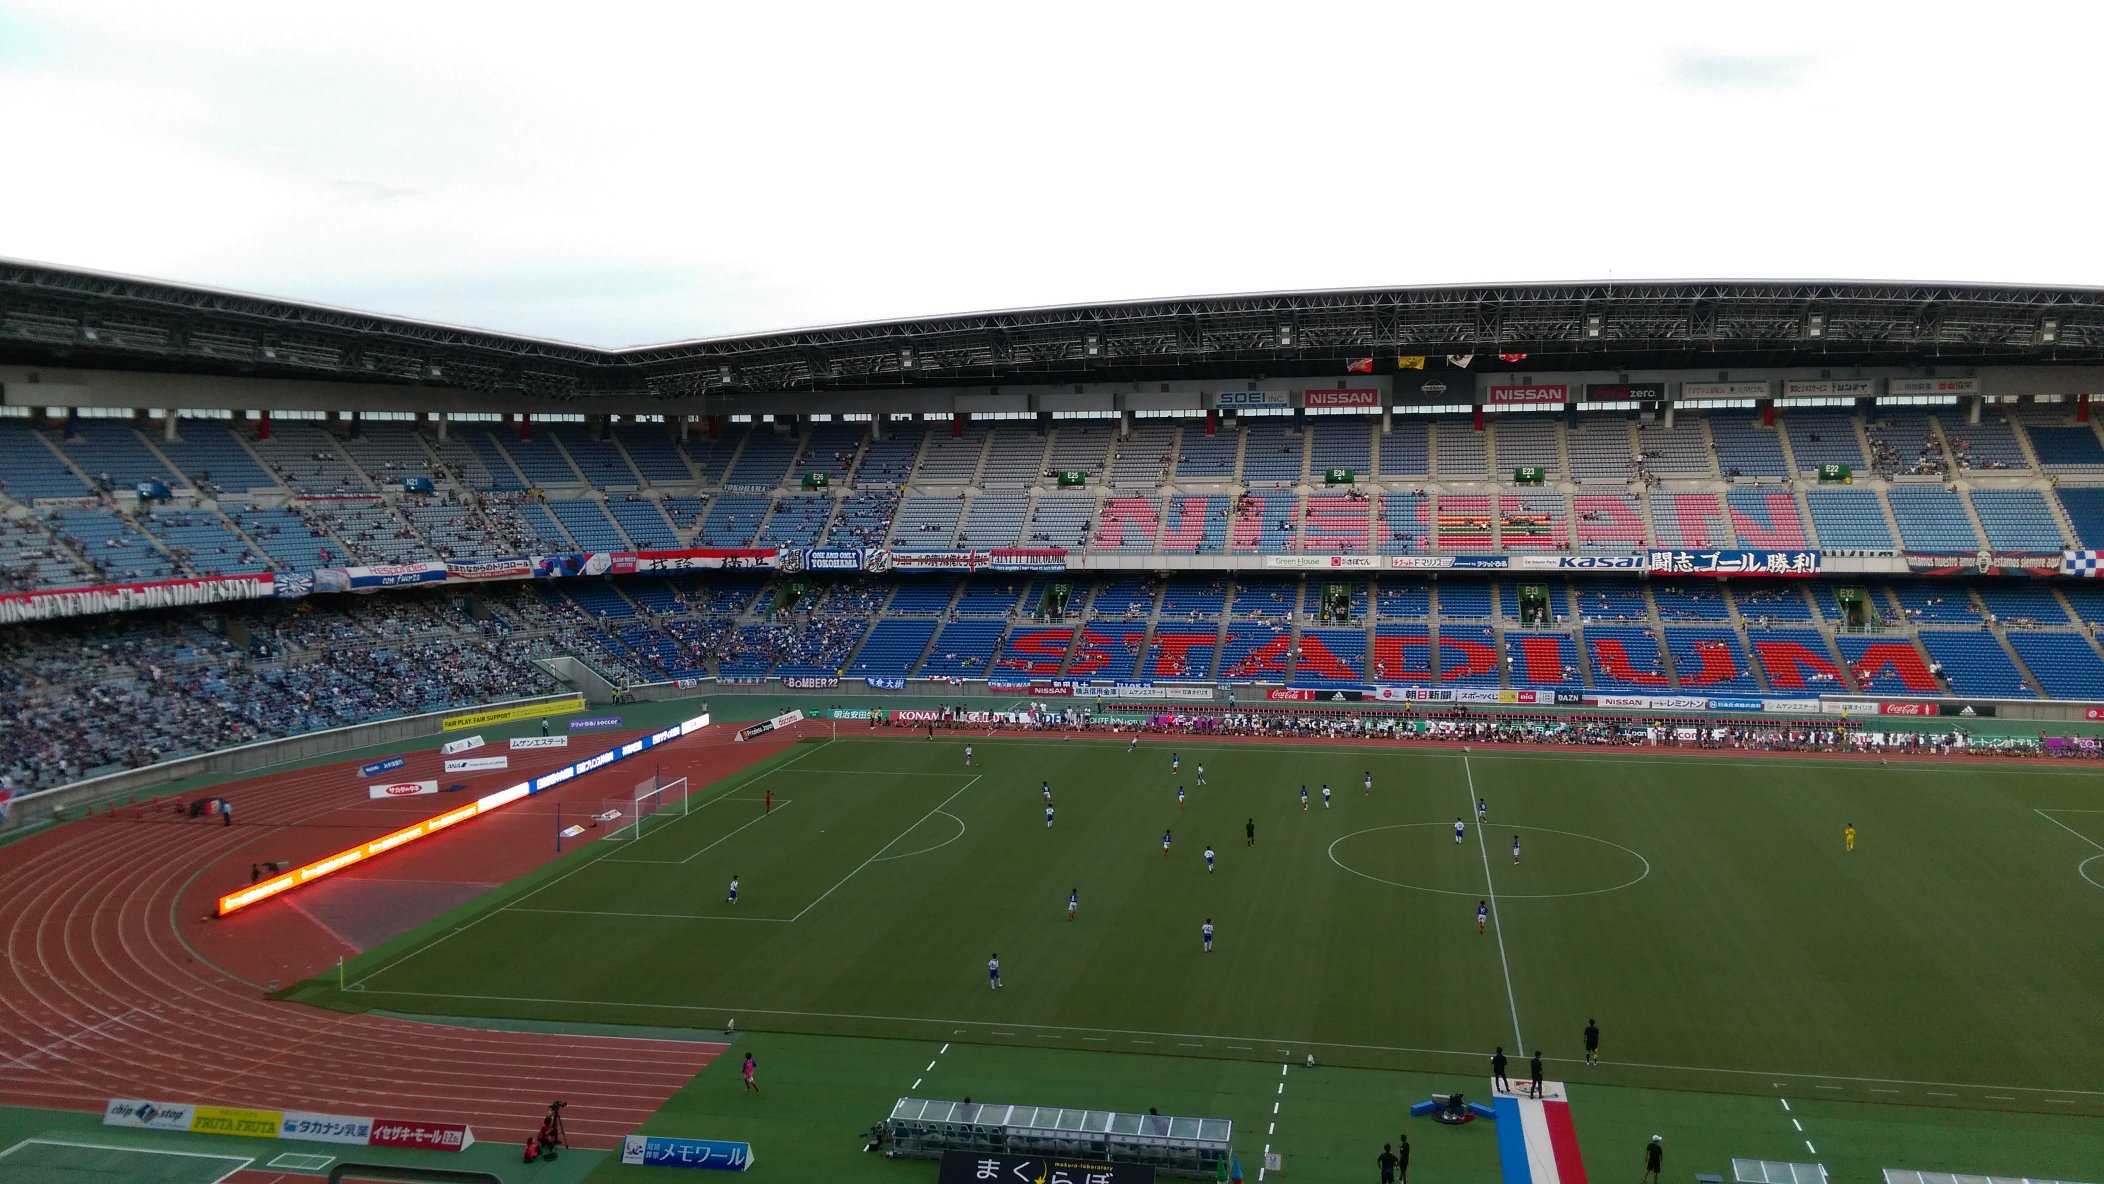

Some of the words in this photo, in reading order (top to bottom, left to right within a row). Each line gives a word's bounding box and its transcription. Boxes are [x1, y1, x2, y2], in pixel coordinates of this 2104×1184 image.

[1221, 393, 1266, 403] SOEI
[1310, 393, 1373, 404] NISSAN
[1495, 389, 1563, 401] NISSAN
[447, 561, 530, 573] 生まれながらのトリコロール
[811, 559, 859, 568] YOKOHAMA
[1275, 557, 1298, 565] Green
[1299, 557, 1320, 566] House
[1700, 551, 1762, 573] ゴール
[1766, 551, 1816, 574] 勝利
[1993, 557, 2020, 568] estamos
[1056, 584, 1067, 592] E15
[1331, 585, 1343, 593] E14
[1526, 587, 1538, 595] E13
[1840, 589, 1854, 598] E12
[997, 628, 1939, 691] STADIUM
[1406, 690, 1452, 700] 朝日新聞
[1461, 692, 1499, 700] スポーツくじ
[1557, 694, 1579, 702] DAZN
[1667, 699, 1704, 708] レミントン
[445, 719, 456, 728] FAIR
[473, 715, 486, 724] FAIR
[487, 712, 511, 722] SUPPORT
[778, 714, 798, 726] docomo
[513, 737, 567, 748] ムゲンエステート
[111, 1104, 133, 1118] chip
[159, 1108, 184, 1121] stop
[194, 1115, 234, 1130] FRUTA
[234, 1118, 276, 1133] FRUTA
[299, 1120, 369, 1138] タカナシ乳業
[659, 1144, 745, 1166] メモワール
